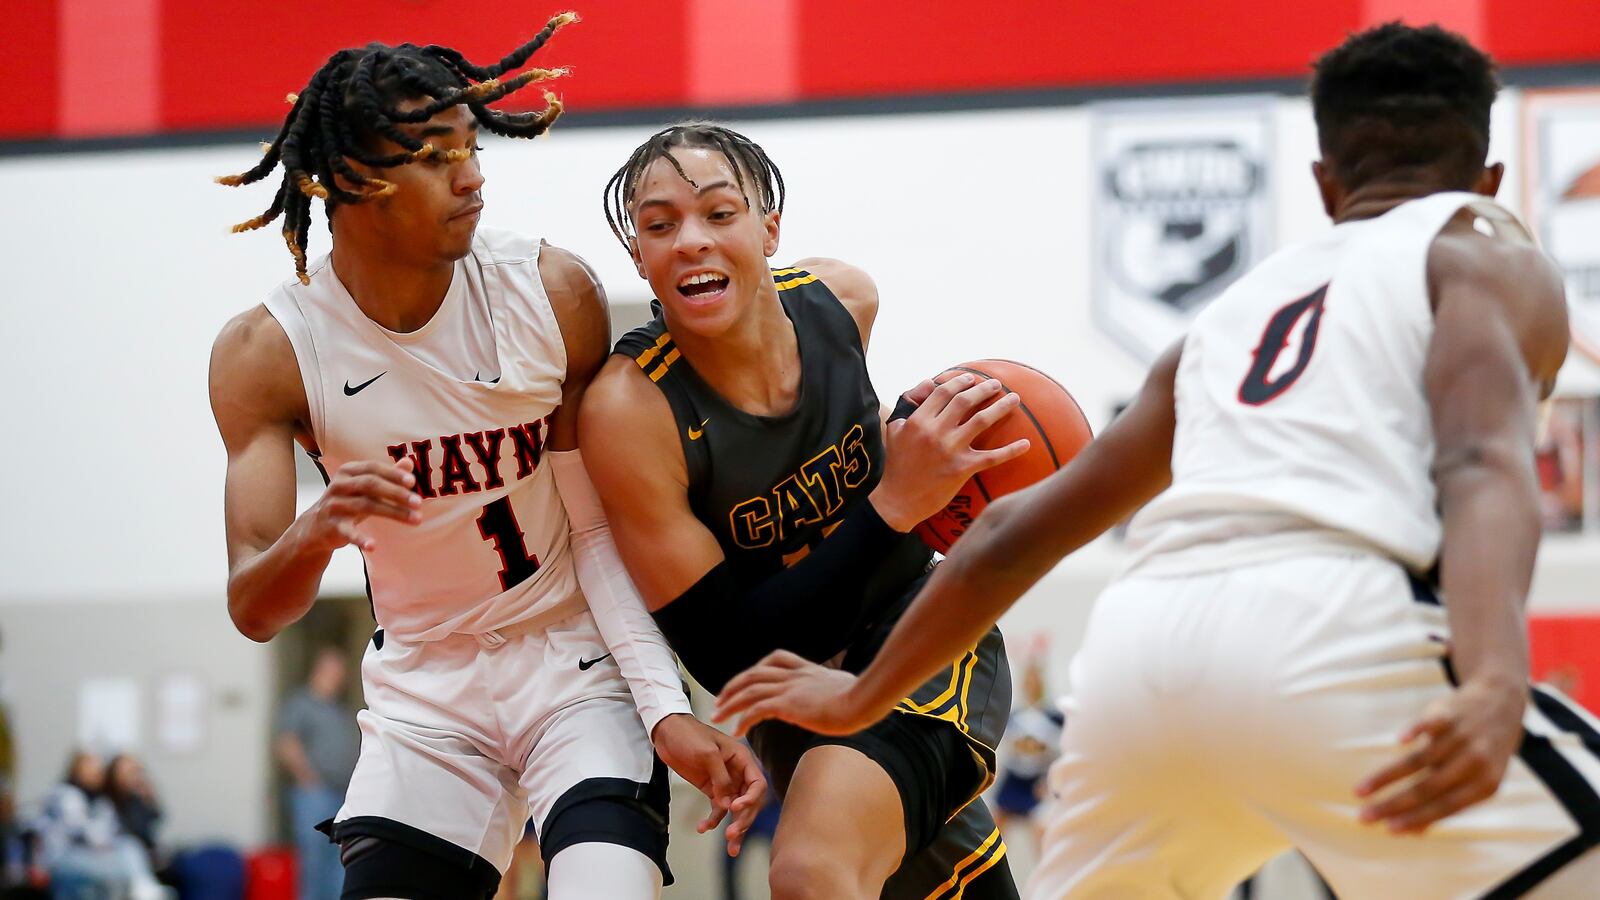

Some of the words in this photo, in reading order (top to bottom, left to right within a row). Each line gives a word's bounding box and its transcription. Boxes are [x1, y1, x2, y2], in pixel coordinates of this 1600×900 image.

[1238, 282, 1329, 406] 0
[387, 404, 560, 499] WAYN
[729, 424, 871, 549] CATS
[476, 495, 541, 592] 1
